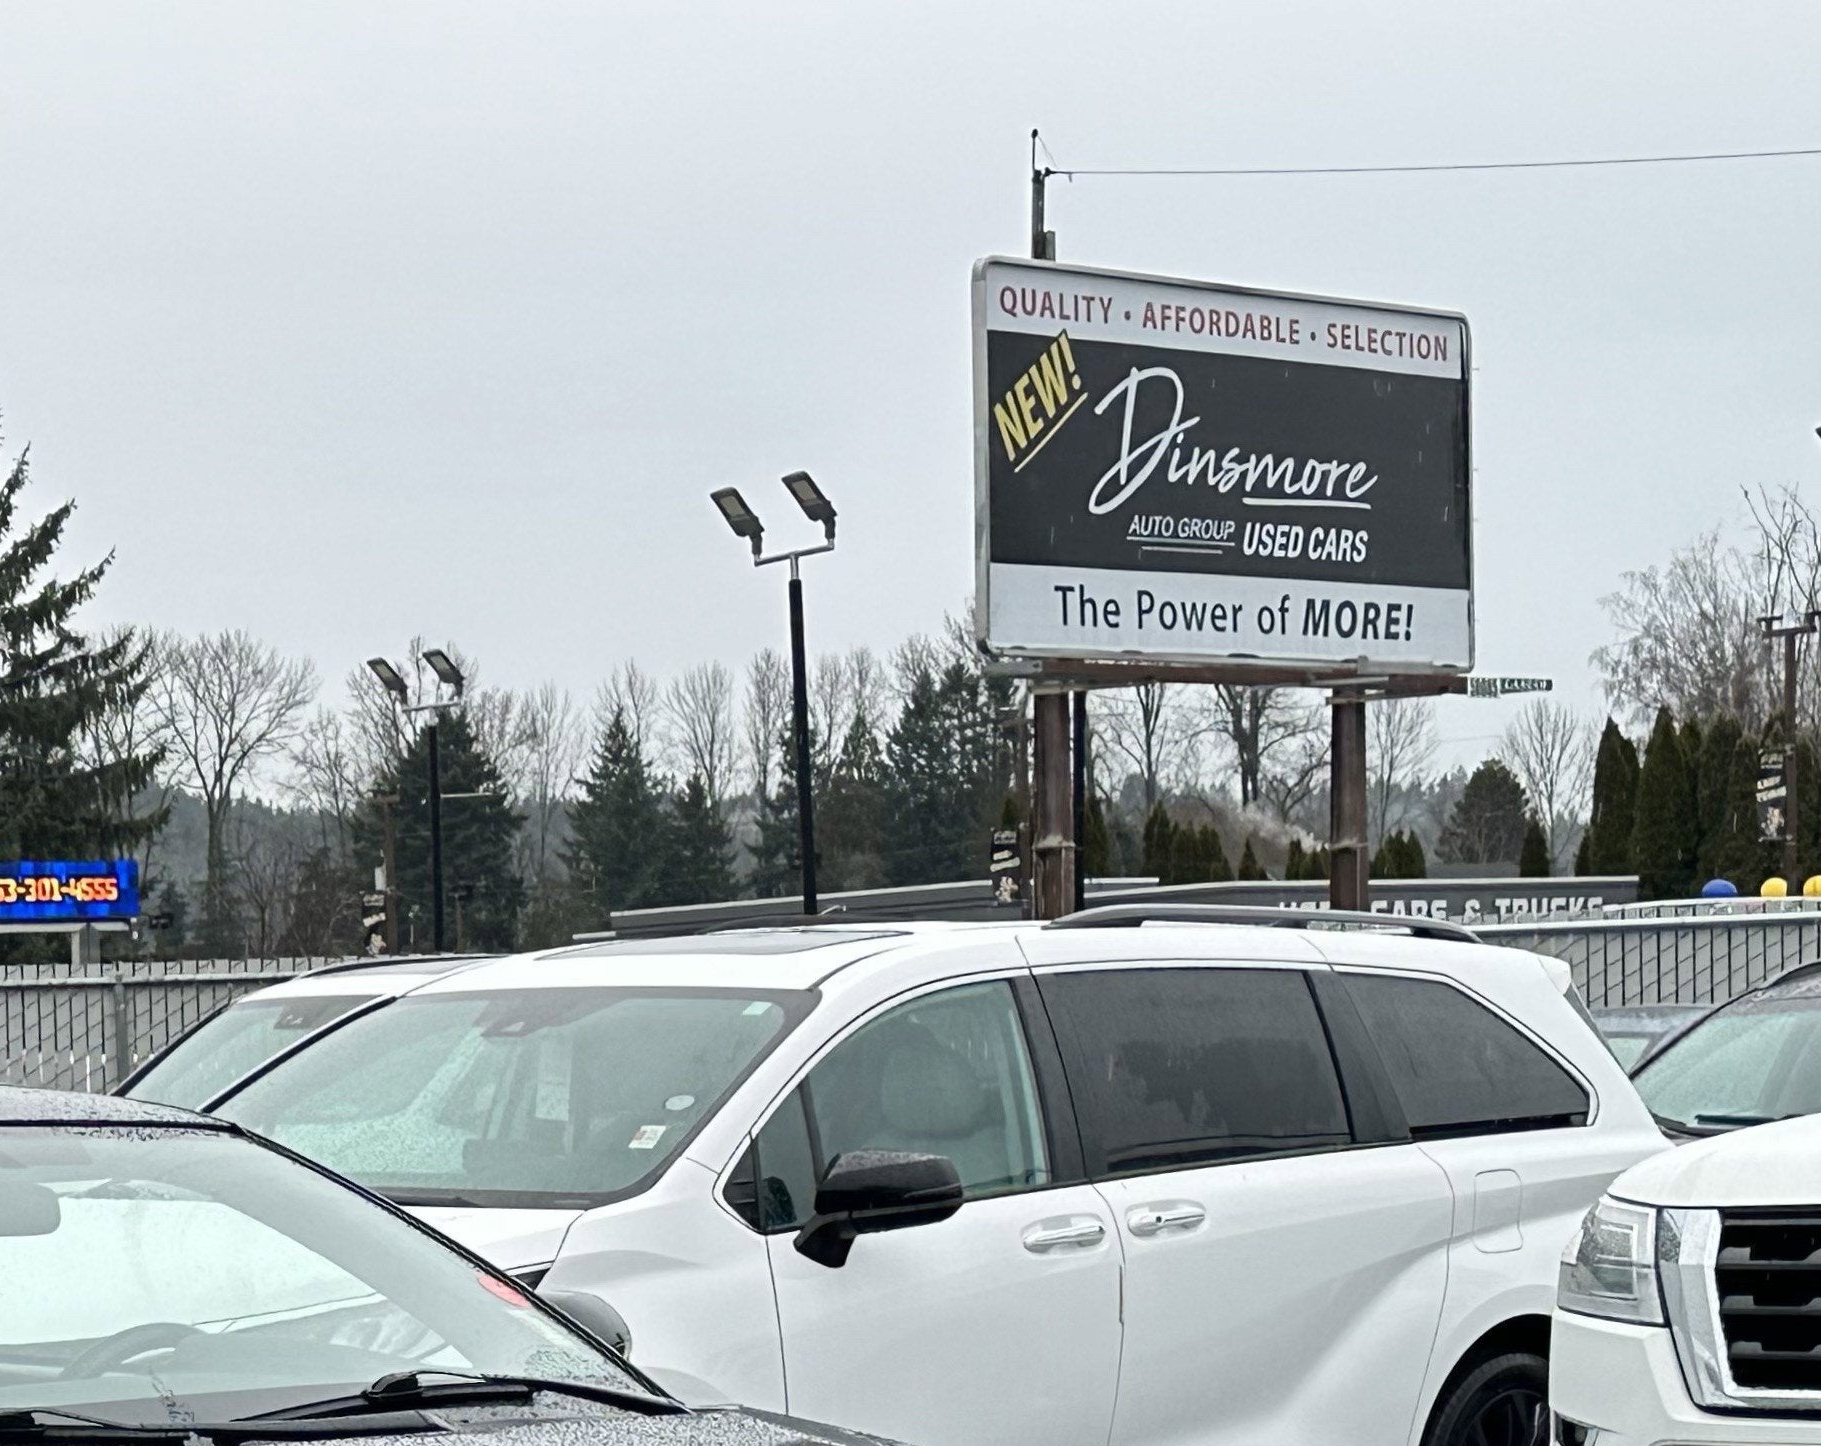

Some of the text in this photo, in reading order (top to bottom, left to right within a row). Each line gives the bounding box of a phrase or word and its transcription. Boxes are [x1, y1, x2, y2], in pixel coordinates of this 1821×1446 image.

[999, 286, 1449, 363] QUALITY AFFORDABLE SELECTION
[993, 330, 1082, 462] NEW!
[1088, 366, 1379, 515] Dinsmore
[1128, 515, 1236, 541] AUTO GROUP
[1242, 522, 1369, 563] USED CARS
[1054, 584, 1414, 642] The Power of MORE!
